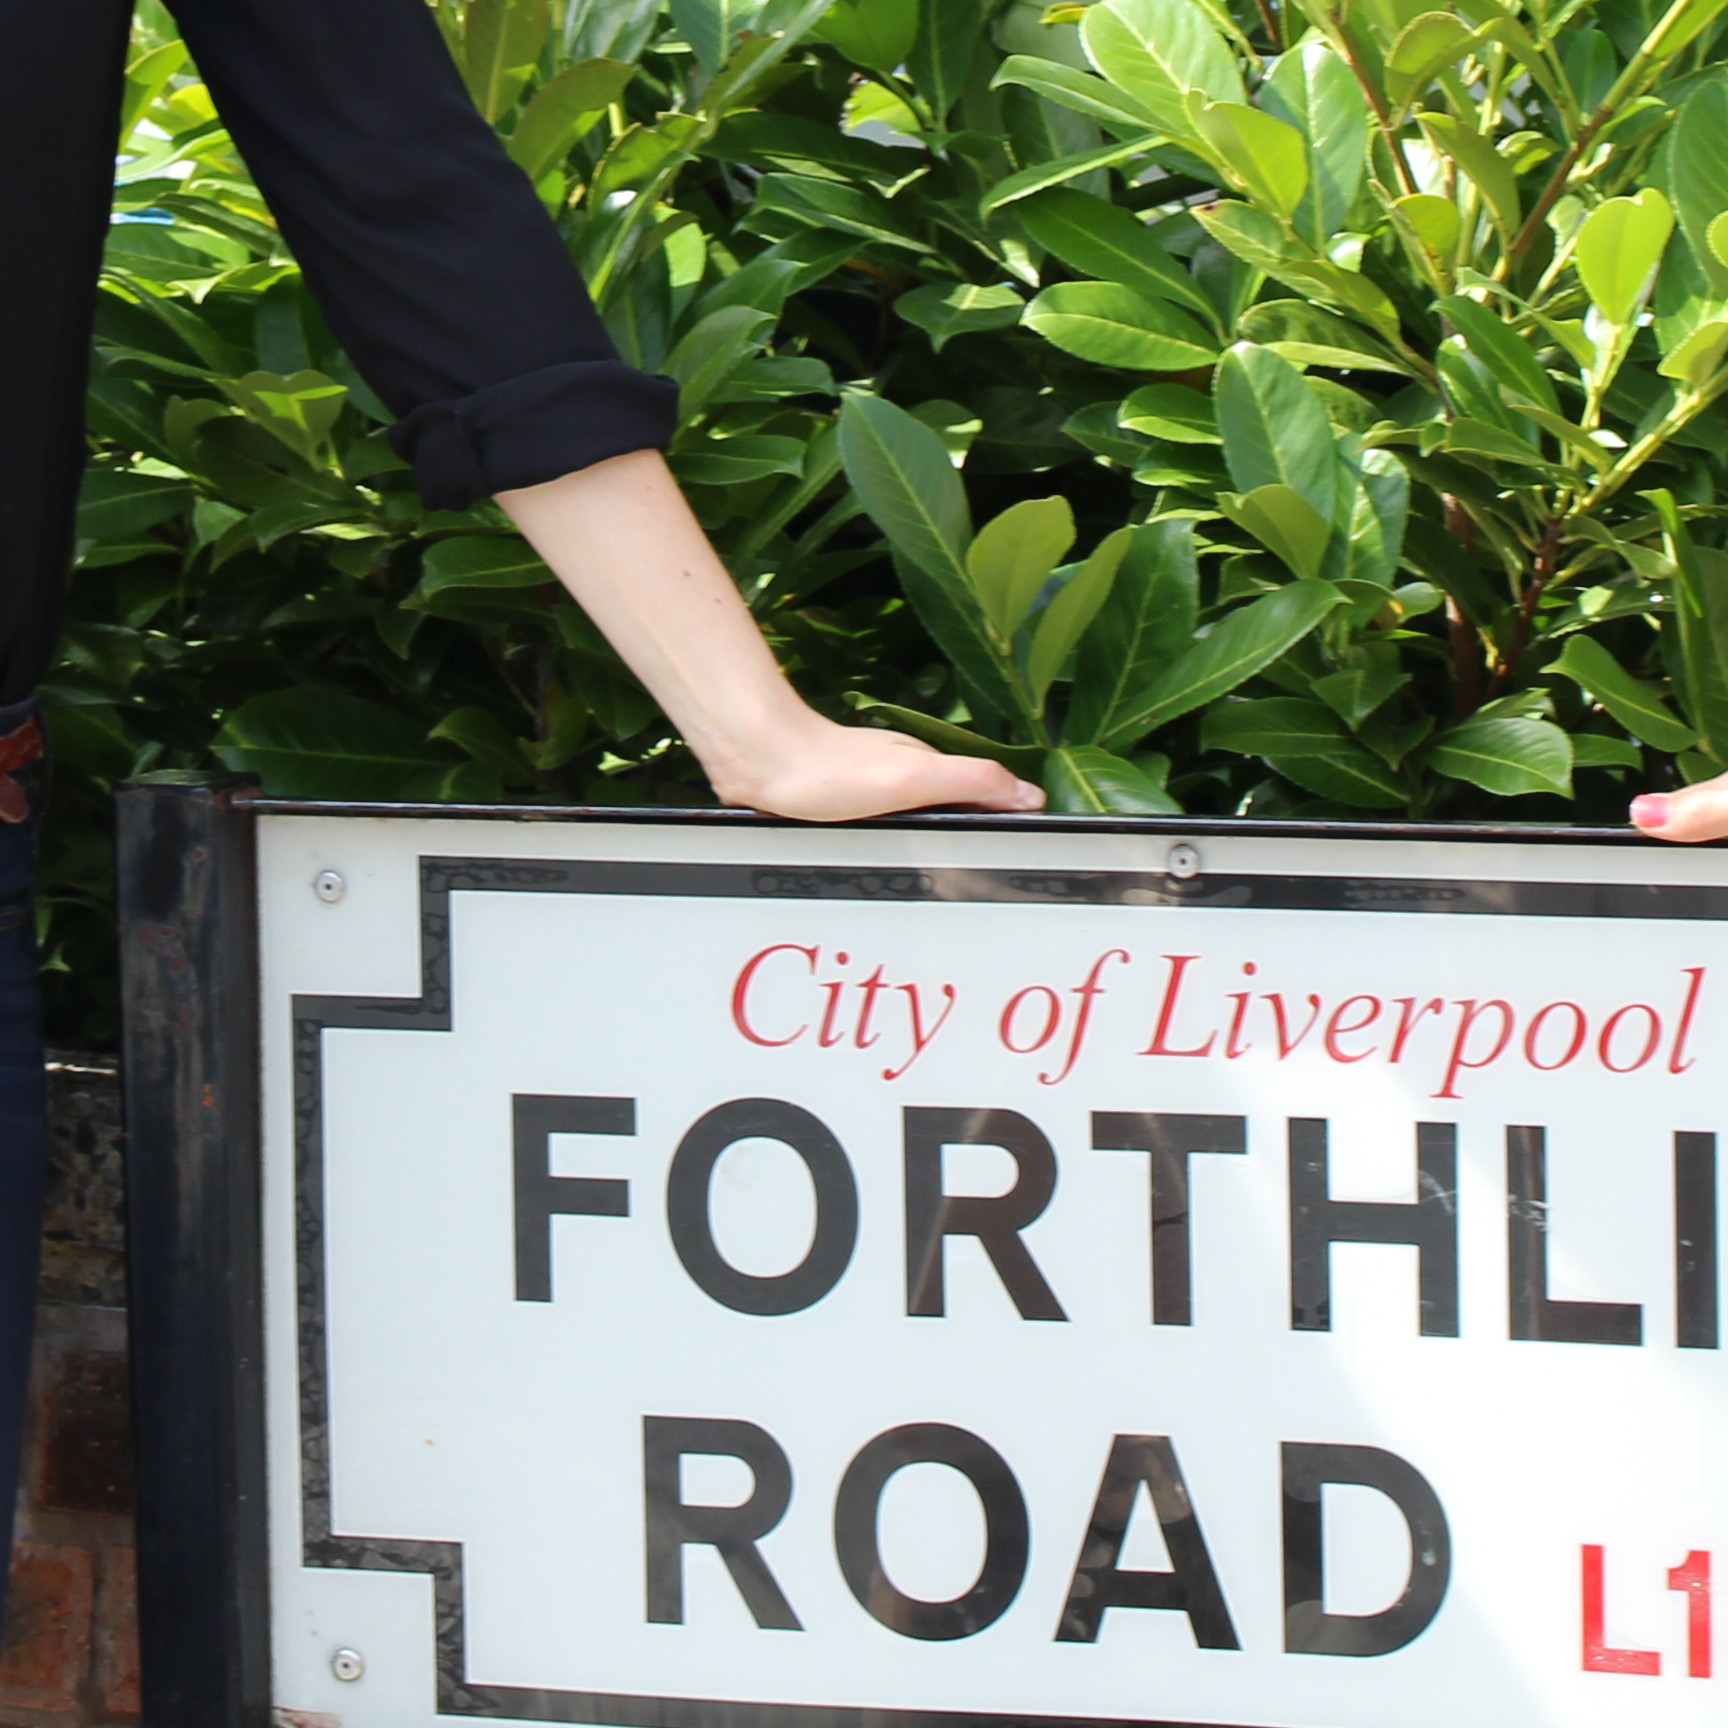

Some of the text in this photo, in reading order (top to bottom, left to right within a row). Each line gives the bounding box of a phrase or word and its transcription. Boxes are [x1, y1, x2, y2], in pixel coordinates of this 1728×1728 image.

[728, 941, 1708, 1100] City of Liverpool
[640, 1413, 1453, 1660] ROAD
